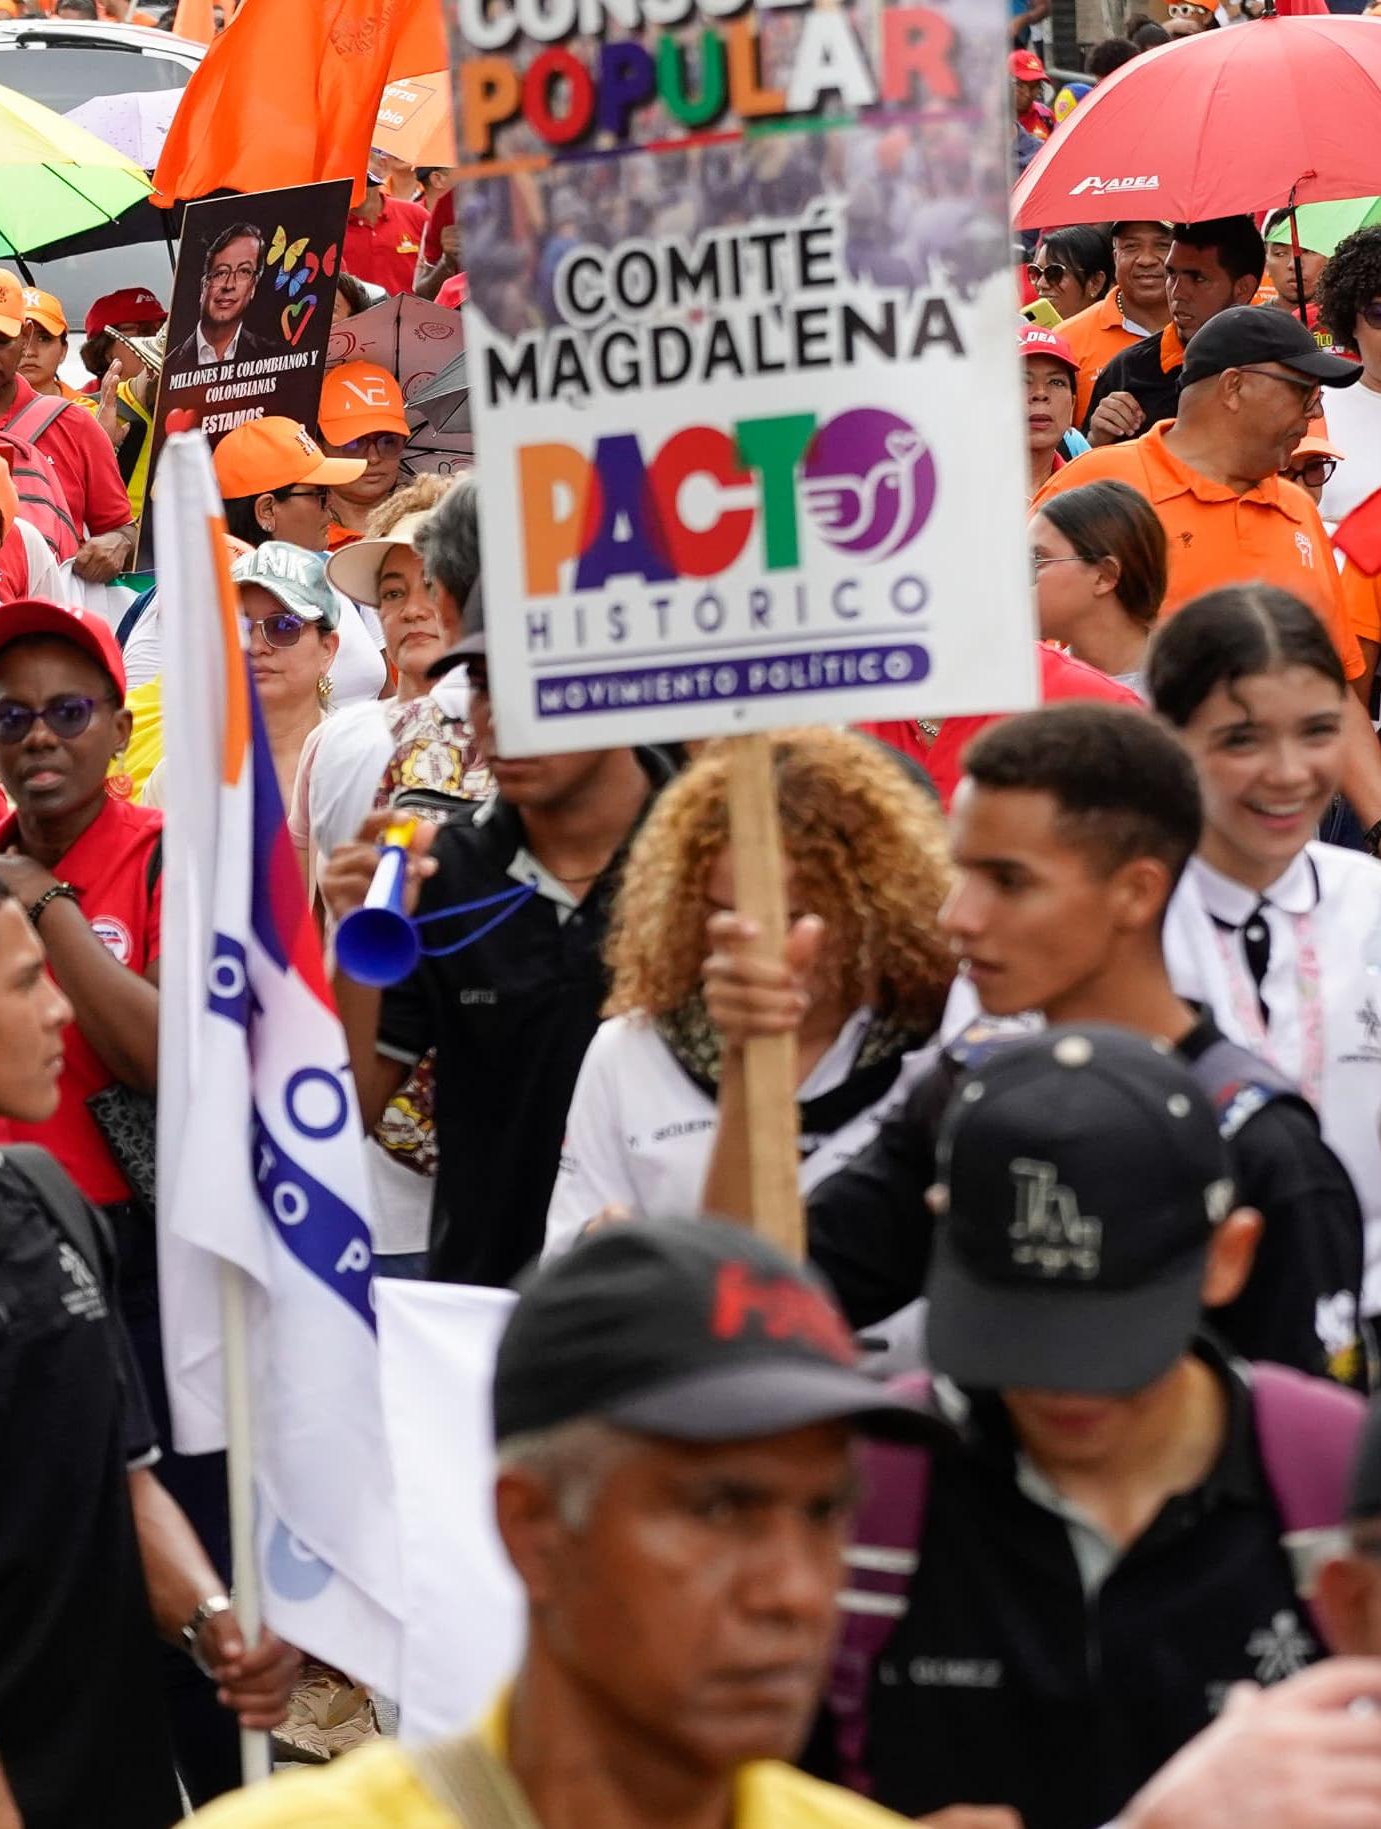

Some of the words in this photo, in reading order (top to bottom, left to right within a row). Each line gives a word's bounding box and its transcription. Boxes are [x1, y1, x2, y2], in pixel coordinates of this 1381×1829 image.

[460, 8, 960, 152] POPULAR
[566, 206, 837, 318] COMITÉ
[169, 366, 218, 391] MILLONES
[220, 363, 235, 381] DE
[237, 353, 308, 378] COLOMBIANOS
[311, 350, 319, 366] Y
[205, 377, 277, 403] COLOMBIANAS
[484, 297, 967, 406] MAGDALENA
[516, 408, 937, 597] PACTO
[526, 574, 930, 652] HISTÓRICO
[539, 667, 739, 713] MOVIMIENTO
[748, 649, 916, 692] POLÍTICO
